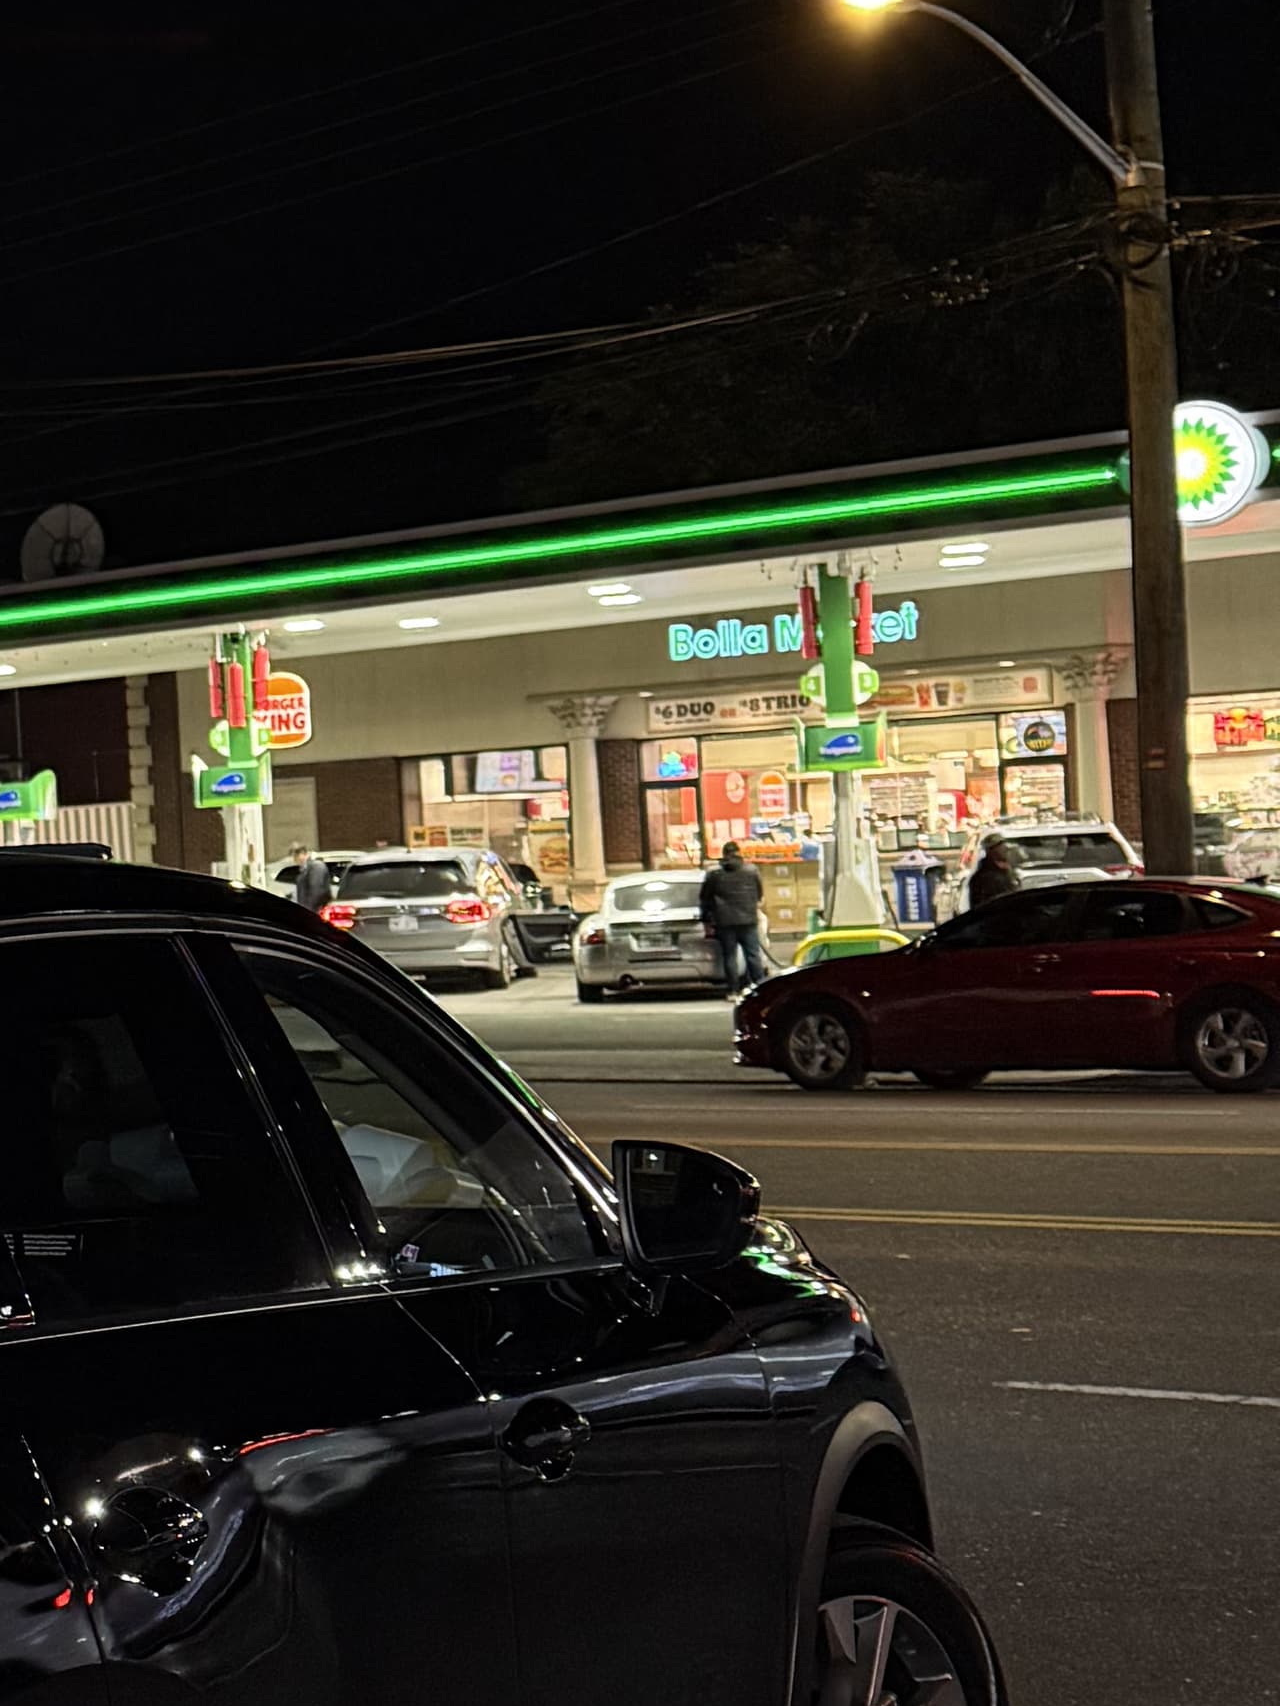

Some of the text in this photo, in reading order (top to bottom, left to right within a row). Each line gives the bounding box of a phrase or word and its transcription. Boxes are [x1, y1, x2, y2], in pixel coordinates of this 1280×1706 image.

[668, 600, 919, 661] Bolla Met
[676, 701, 716, 718] DUO
